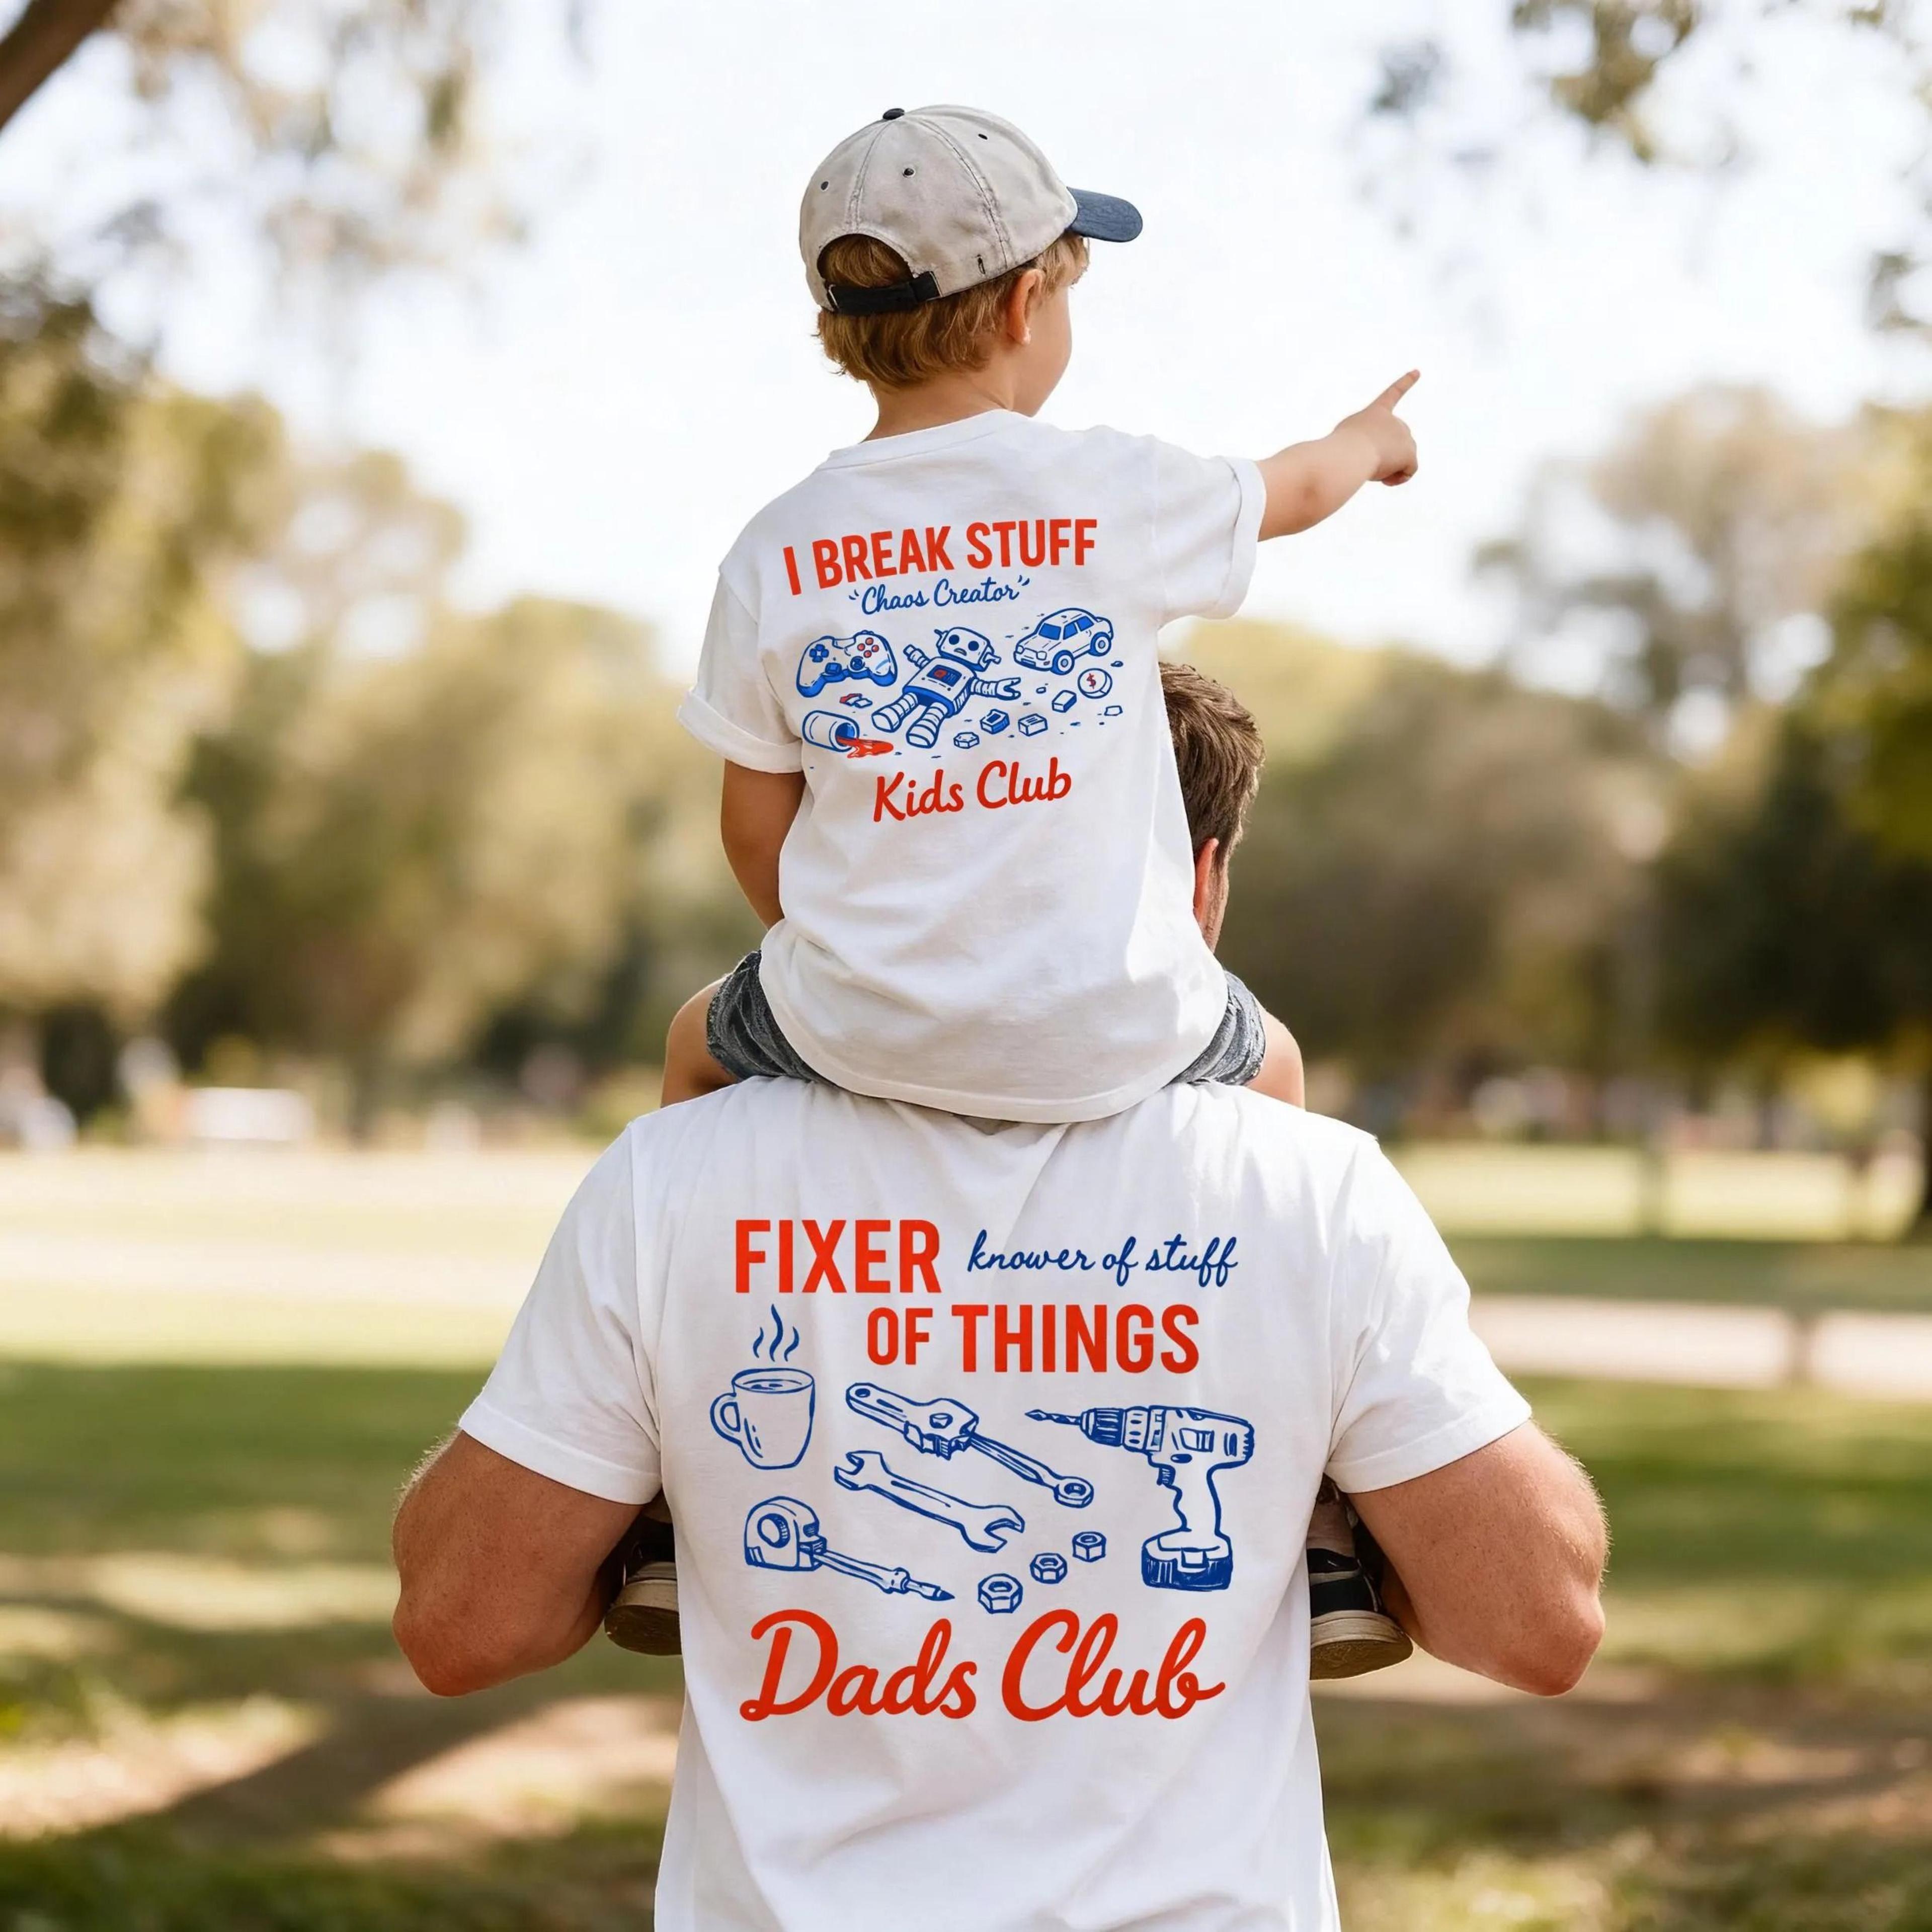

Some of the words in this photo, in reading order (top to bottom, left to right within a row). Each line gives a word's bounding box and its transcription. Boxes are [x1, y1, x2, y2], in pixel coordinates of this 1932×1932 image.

[783, 546, 801, 596] I
[812, 526, 954, 589] BREAK
[965, 519, 1097, 570] STUFF
[873, 768, 964, 822] Kids
[977, 757, 1072, 810] Club
[735, 1219, 942, 1294] FIXER
[967, 1229, 1096, 1272] knower
[1101, 1236, 1138, 1287] of
[1145, 1233, 1237, 1289] stuff
[867, 1307, 934, 1366] OF
[951, 1303, 1199, 1374] THINGS
[739, 1608, 977, 1722] Dads
[1001, 1608, 1226, 1722] Club
